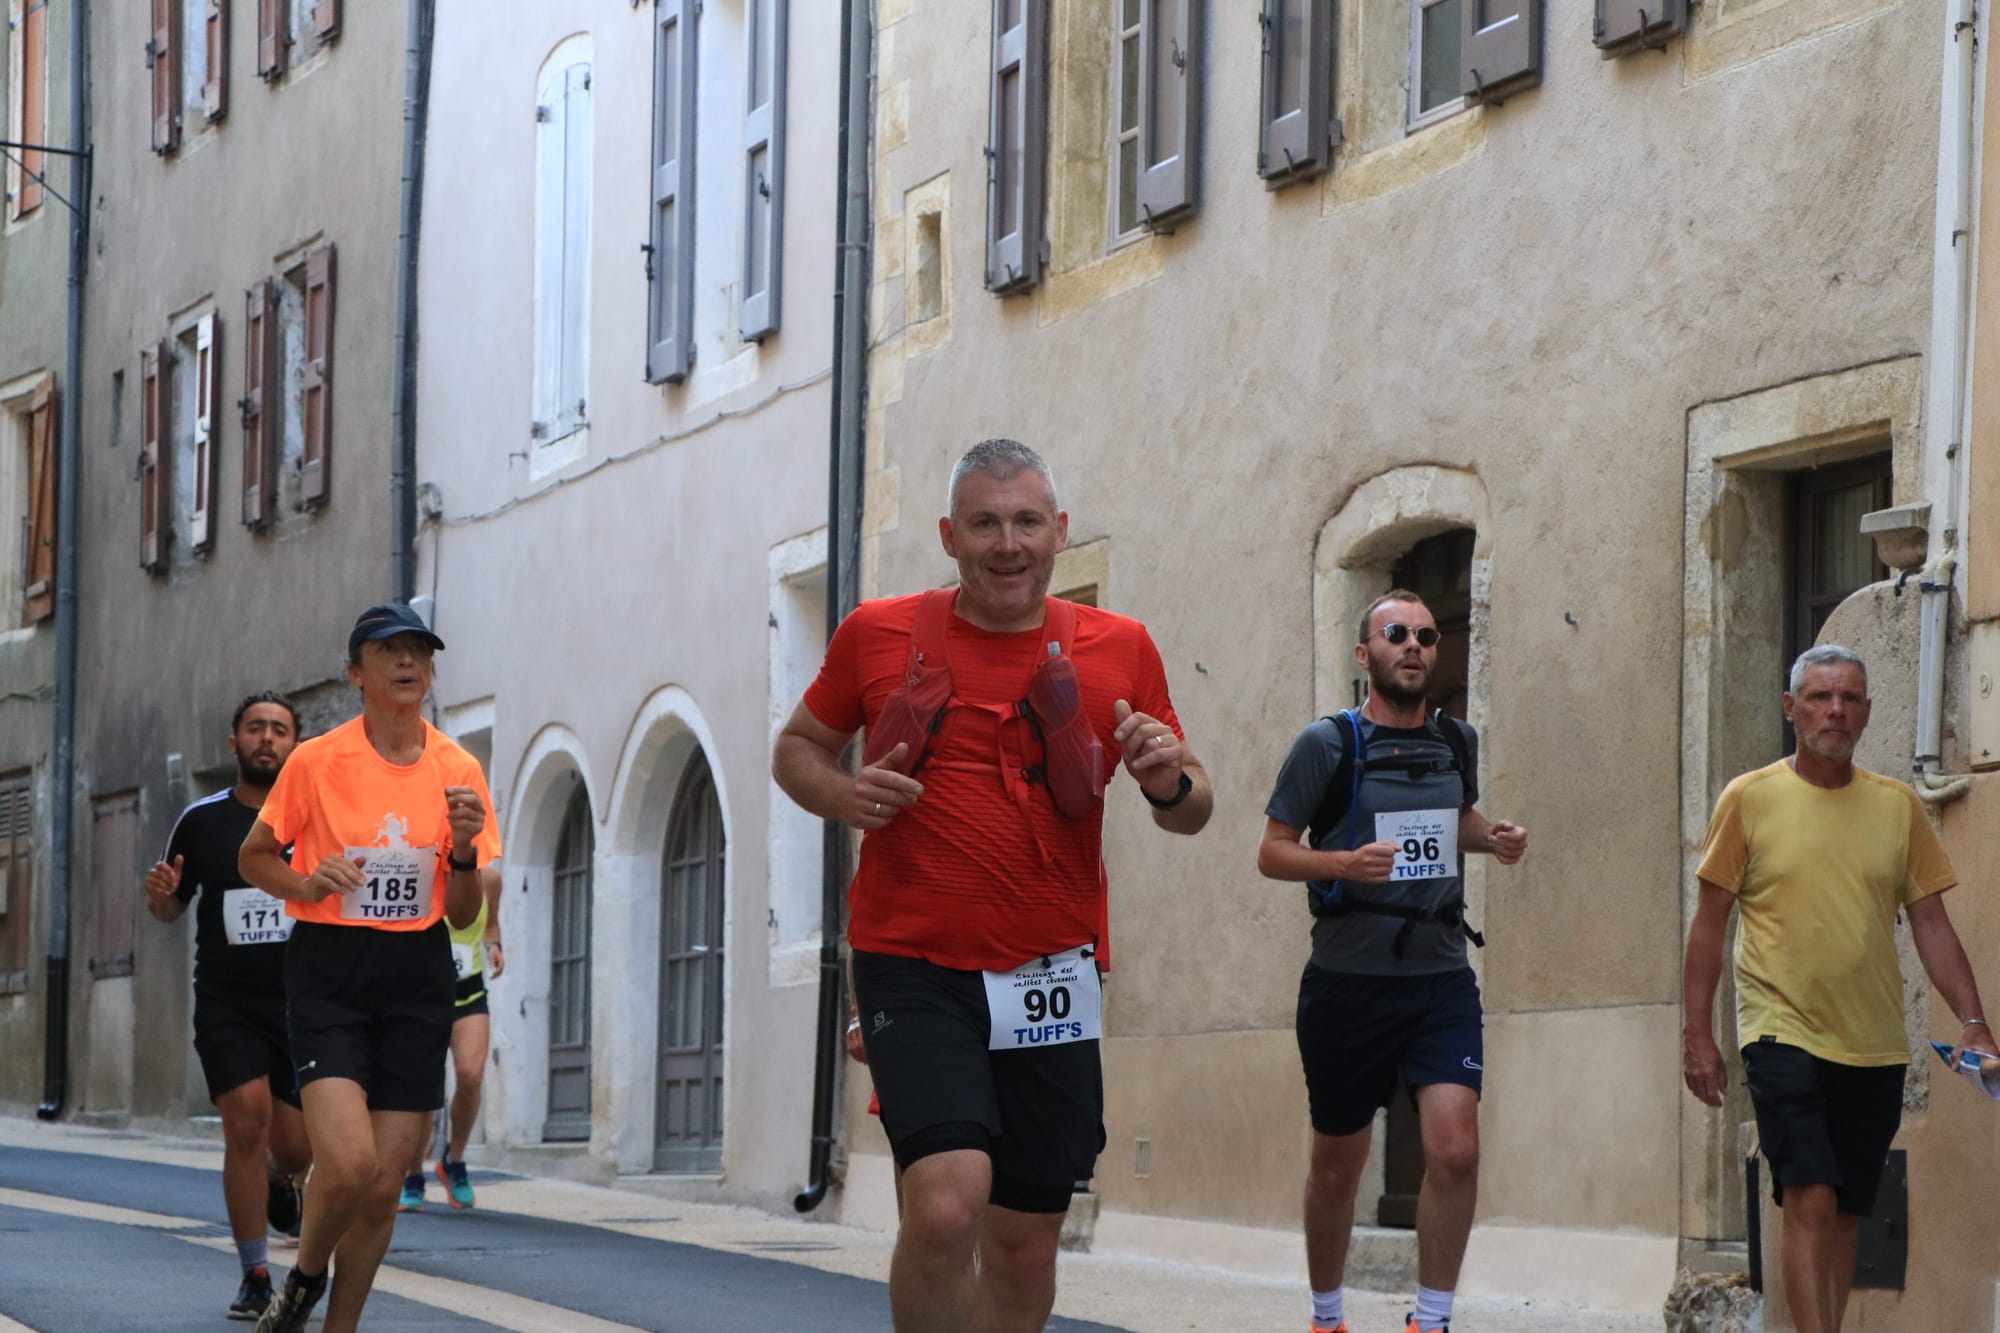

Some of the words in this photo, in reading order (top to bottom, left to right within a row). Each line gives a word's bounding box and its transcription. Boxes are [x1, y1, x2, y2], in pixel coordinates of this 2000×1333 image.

[1403, 837, 1439, 862] 96
[1395, 863, 1446, 877] TUFF'S
[367, 877, 418, 901] 185
[241, 909, 280, 929] 171
[360, 904, 419, 917] TUFF'S
[238, 929, 287, 942] TUFF'S
[1015, 971, 1056, 980] Challenge
[1023, 986, 1071, 1022] 90
[1014, 1021, 1082, 1044] TUFF'S
